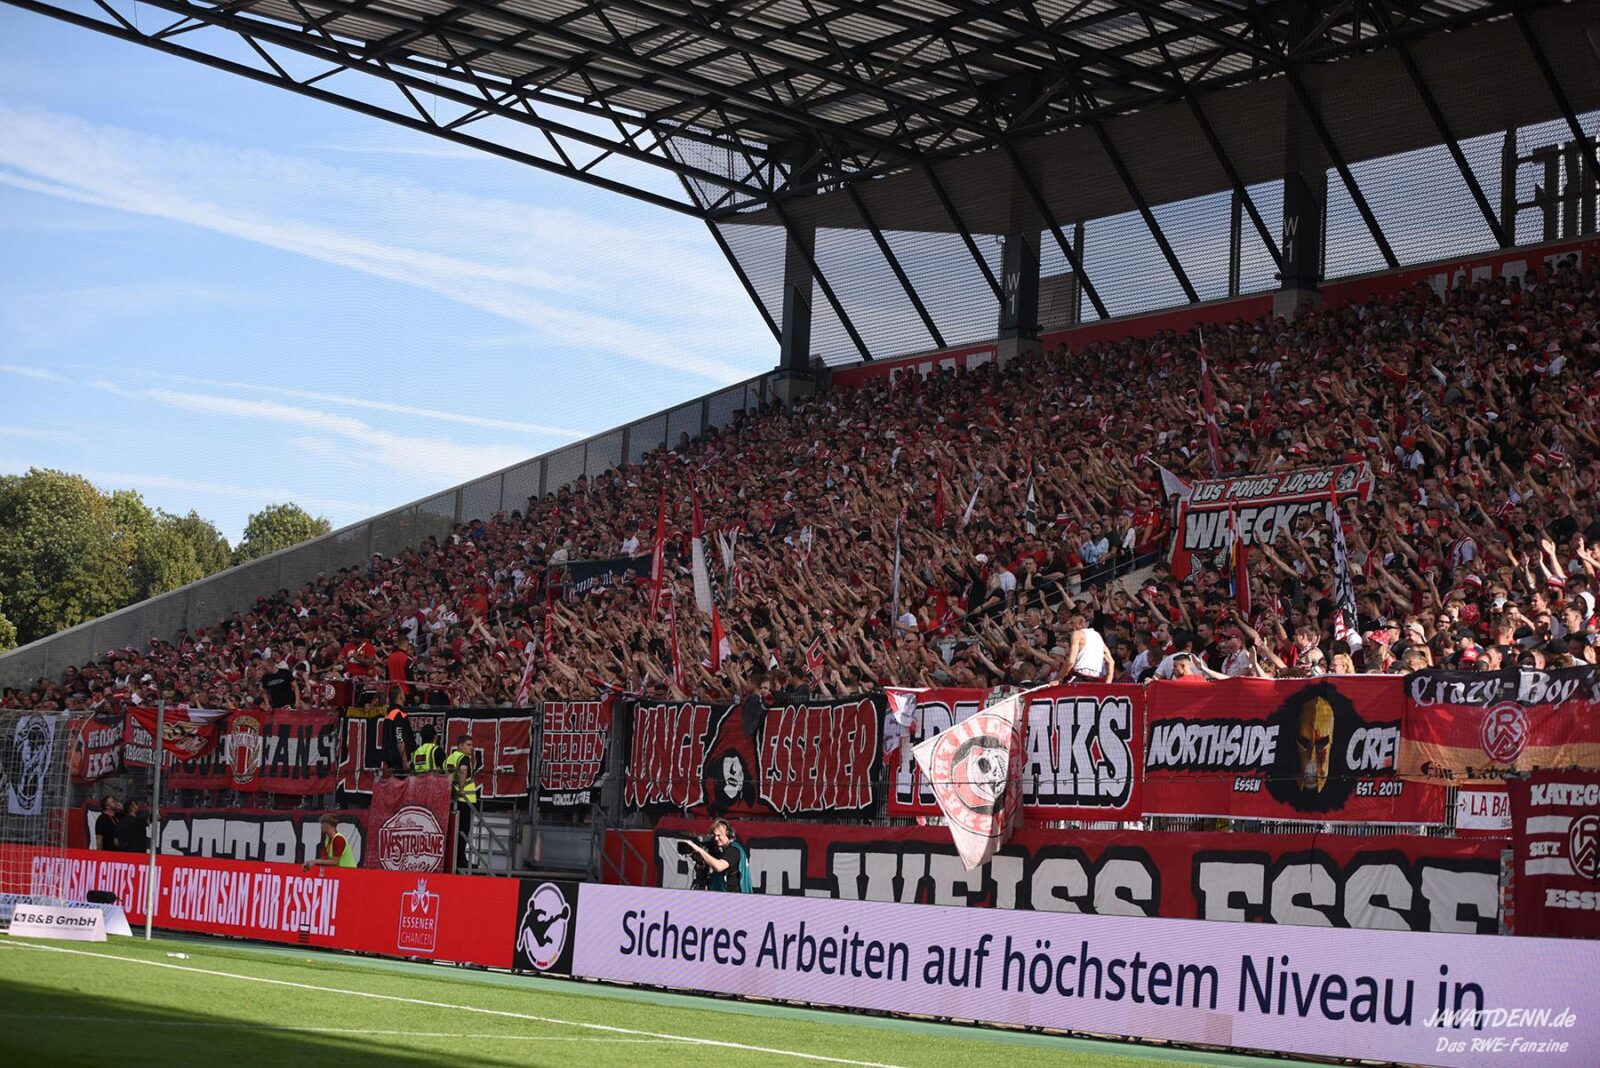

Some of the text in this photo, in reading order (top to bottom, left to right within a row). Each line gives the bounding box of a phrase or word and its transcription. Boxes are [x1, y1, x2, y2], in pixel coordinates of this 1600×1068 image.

[1283, 216, 1299, 236] W
[1287, 240, 1294, 263] 1
[1007, 272, 1021, 290] W
[1009, 295, 1015, 315] 1
[1194, 484, 1225, 501] LOS
[1279, 471, 1334, 493] LOCOS
[1185, 502, 1335, 549] WRECK
[258, 723, 335, 781] FANS
[542, 732, 605, 762] STADION
[624, 702, 712, 809] JUNGE
[757, 699, 878, 814] ESSENER
[897, 697, 1132, 808] FRAKS
[1147, 723, 1280, 767] NORTHSIDE
[1346, 726, 1401, 771] CRE
[1233, 778, 1261, 793] ESSEN
[1356, 781, 1403, 797] EST. 2011
[1530, 782, 1600, 807] KATEG
[1471, 795, 1511, 817] LA BA
[1529, 841, 1561, 857] SEIT
[658, 836, 1152, 917] RT-WEISS
[98, 861, 135, 913] GUTES
[170, 867, 250, 930] GEMEINSAM
[252, 868, 281, 933] FÜR
[282, 877, 339, 936] ESSEN!
[27, 914, 97, 927] B&B GmbH
[402, 917, 434, 930] ESSENER
[400, 931, 433, 946] CHANCEN
[619, 910, 1484, 1030] Sicheres Arbeiten auf höchstem Niveau in
